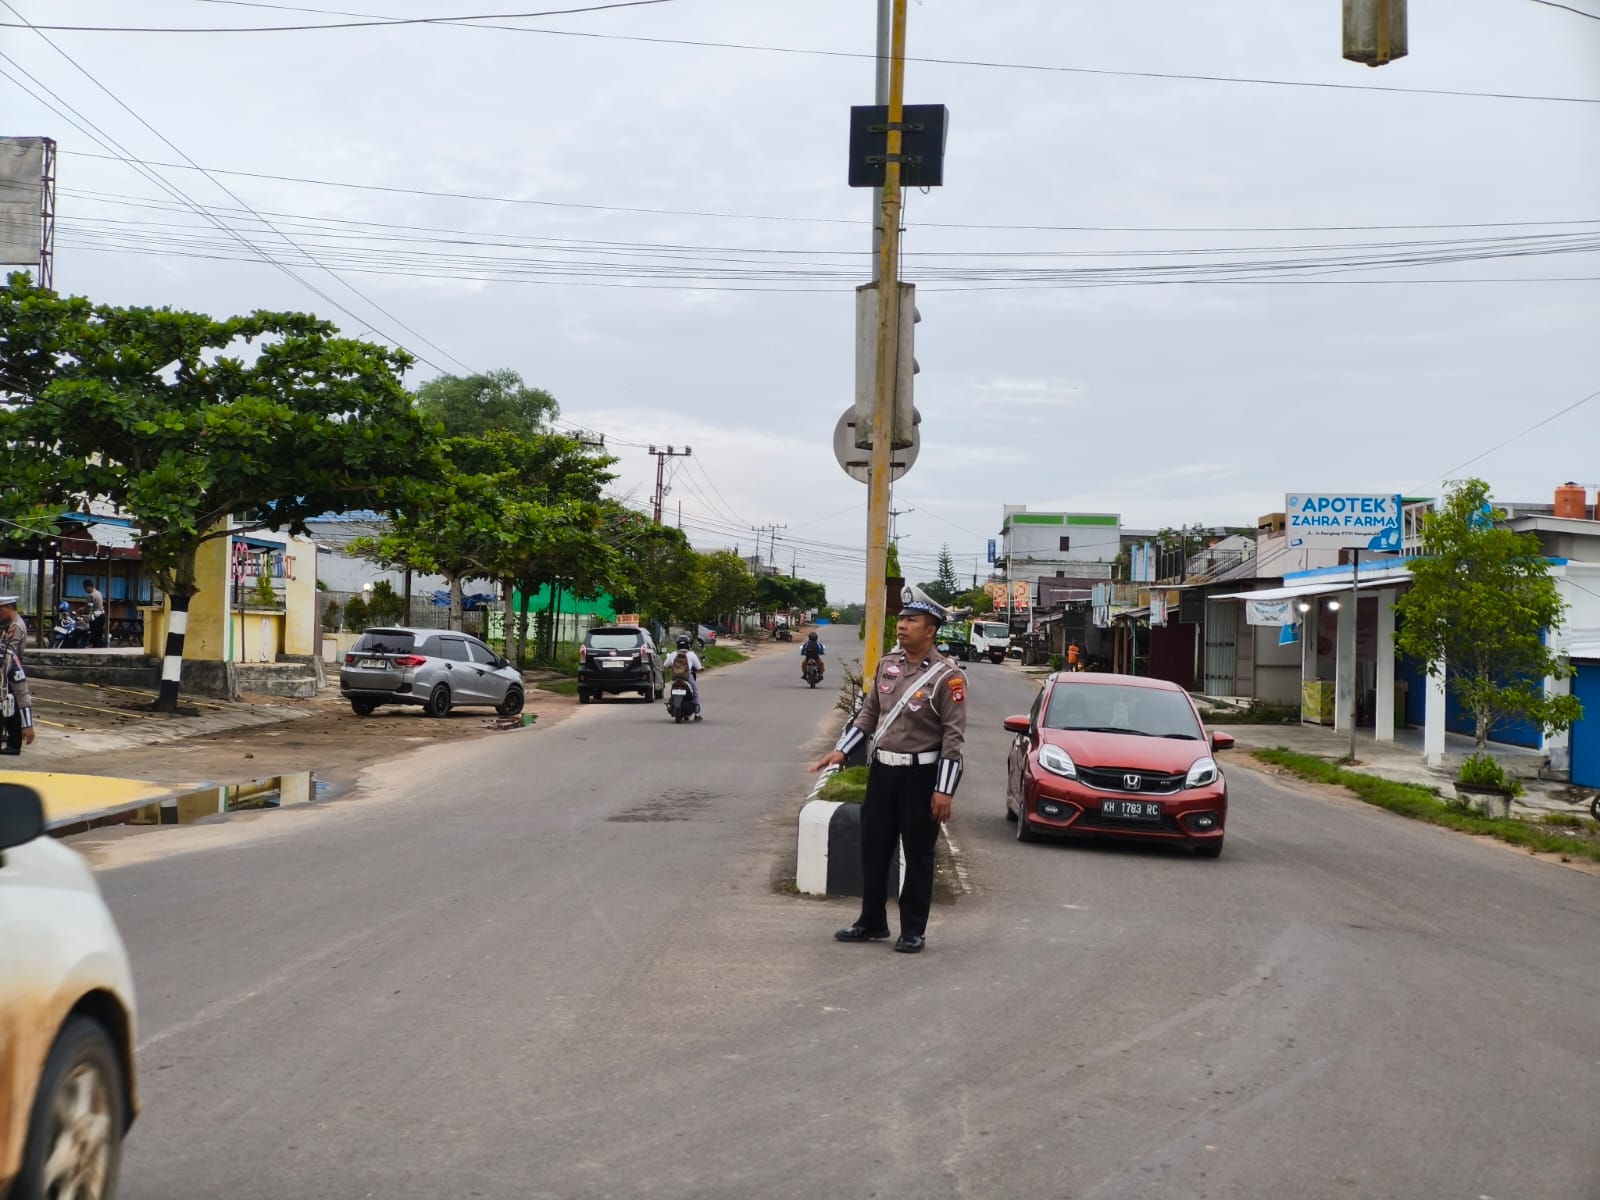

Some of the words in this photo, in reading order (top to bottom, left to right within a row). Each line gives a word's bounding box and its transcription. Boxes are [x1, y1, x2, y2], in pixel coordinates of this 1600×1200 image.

[1302, 497, 1386, 513] APOTEK
[1291, 515, 1340, 526] ZAHRA
[1344, 515, 1396, 527] FARMA
[1103, 801, 1115, 813] KH
[1121, 802, 1142, 814] 1783
[1146, 804, 1158, 815] RC
